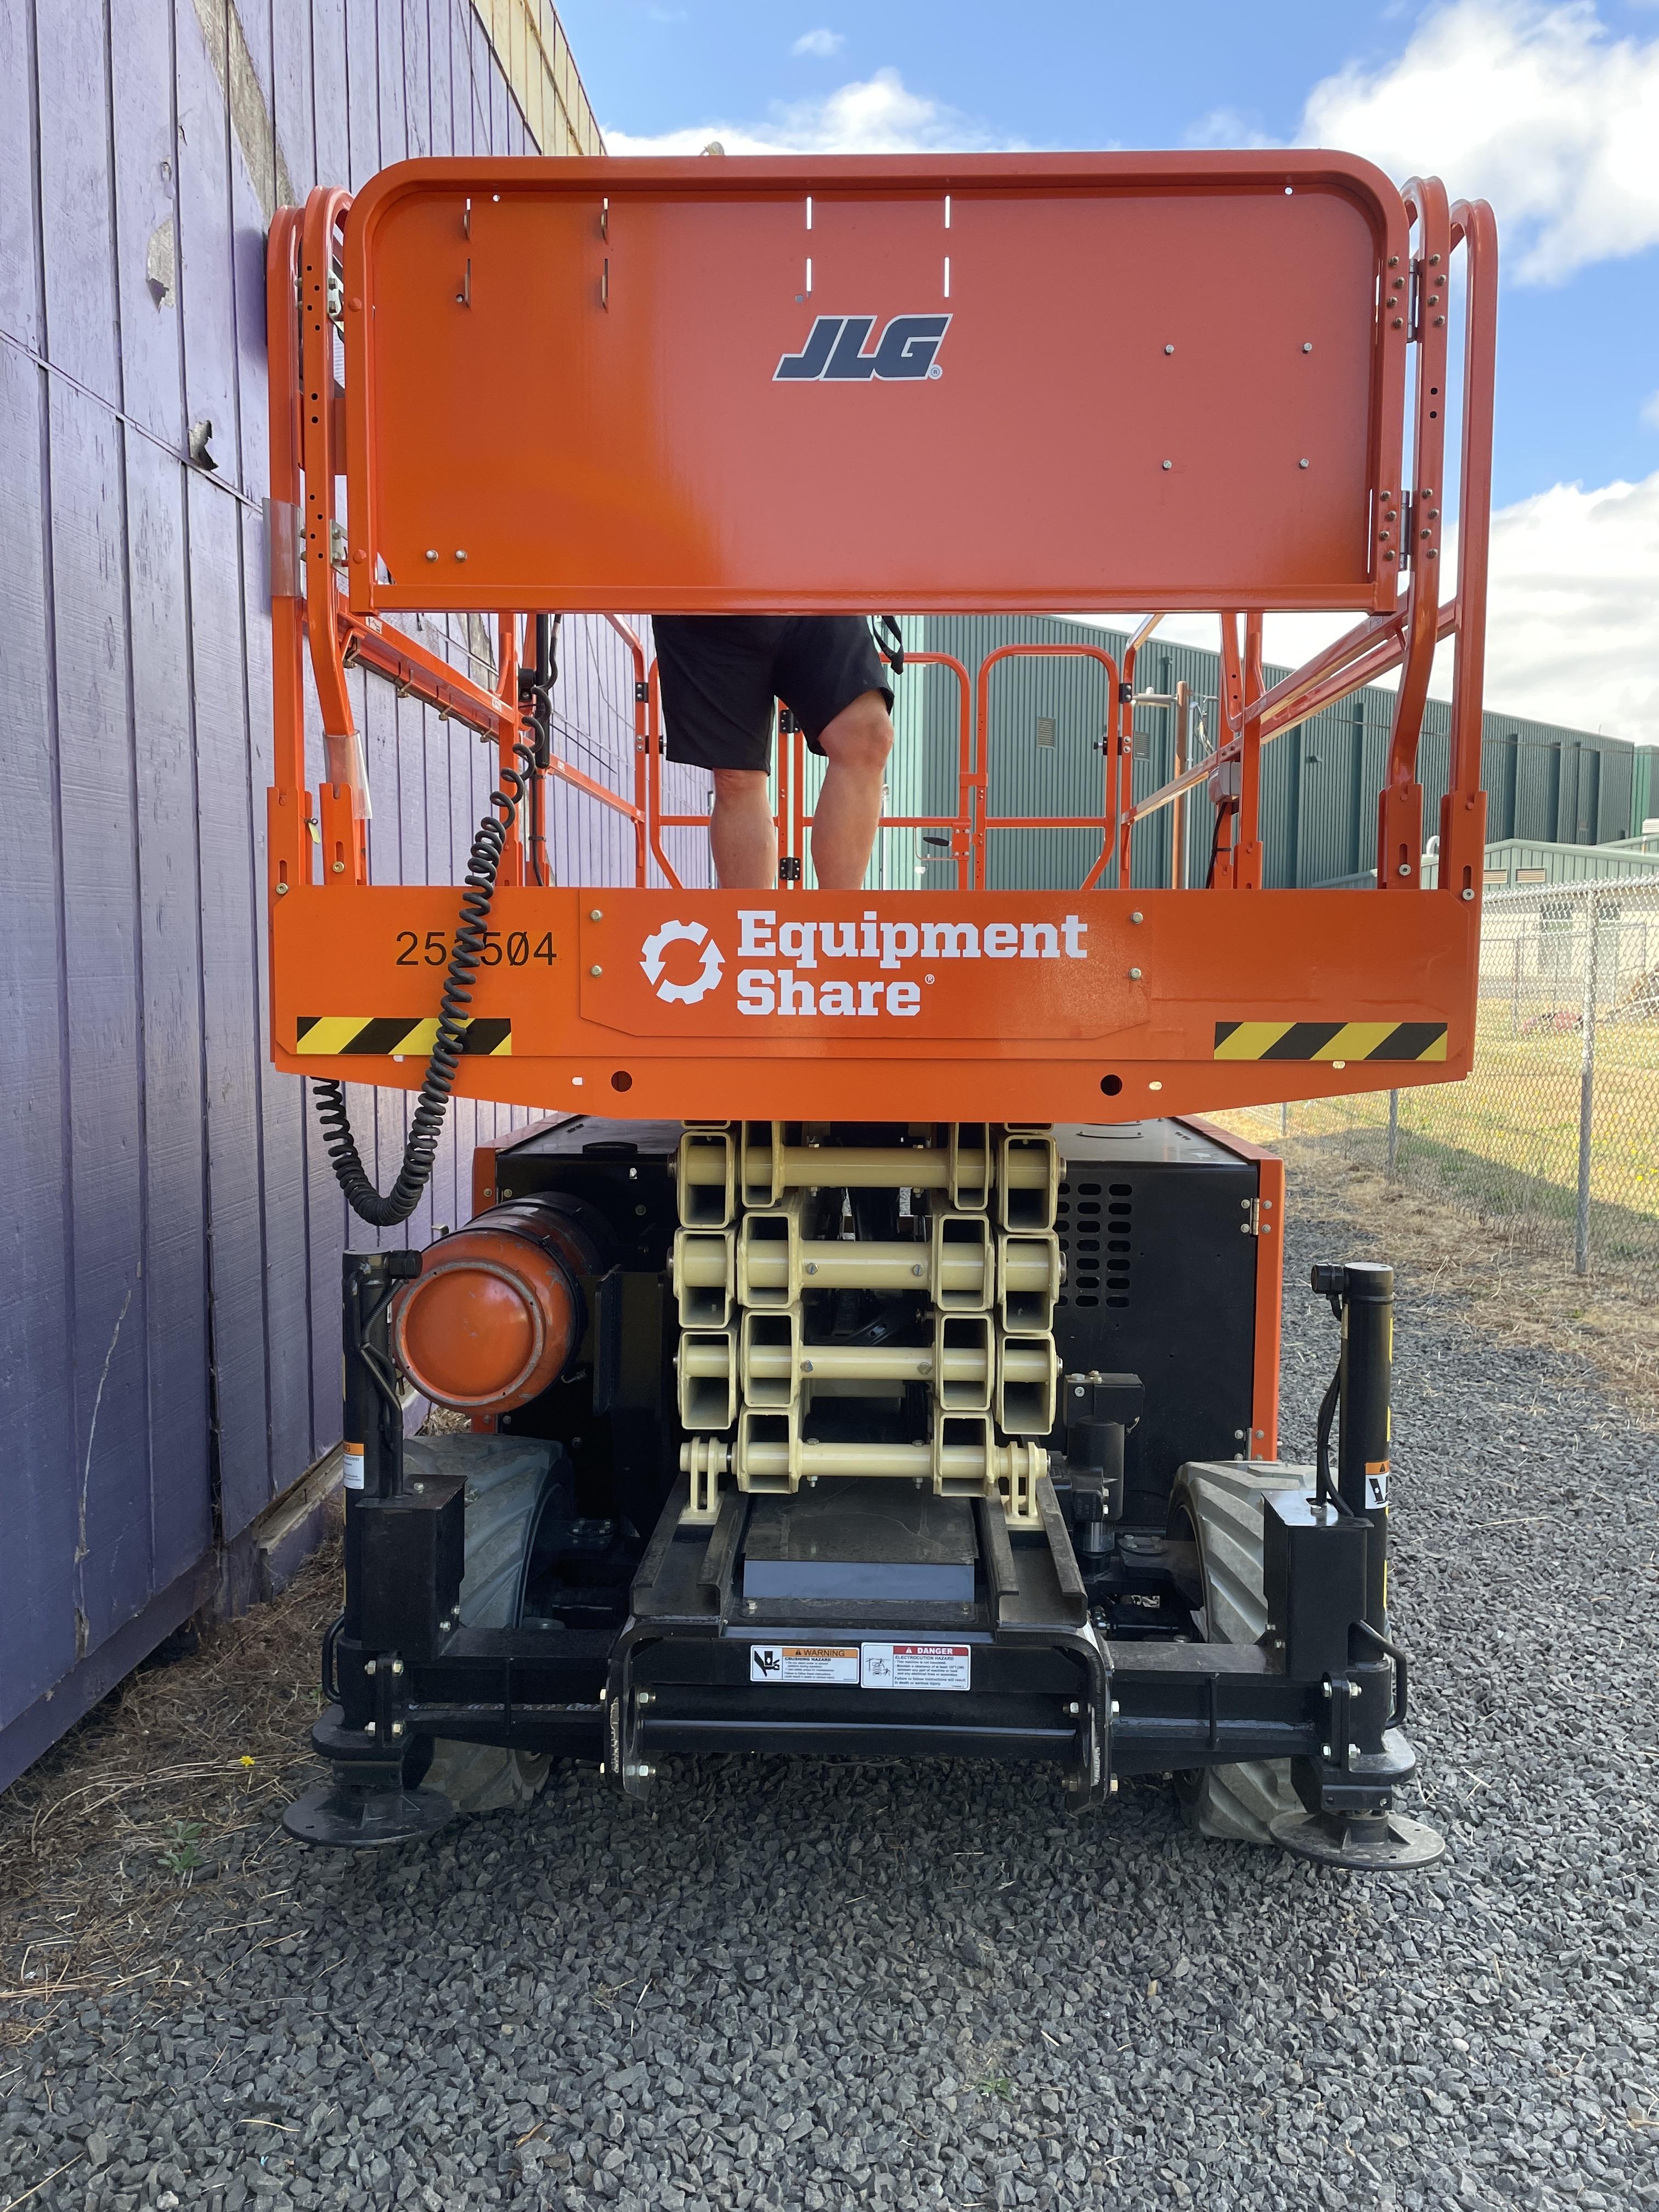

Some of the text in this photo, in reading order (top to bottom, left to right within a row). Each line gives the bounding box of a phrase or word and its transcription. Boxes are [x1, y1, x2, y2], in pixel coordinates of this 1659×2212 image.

[772, 313, 953, 381] JLG
[396, 931, 557, 966] 25504
[736, 910, 1087, 969] Equipment
[736, 969, 921, 1016] Share
